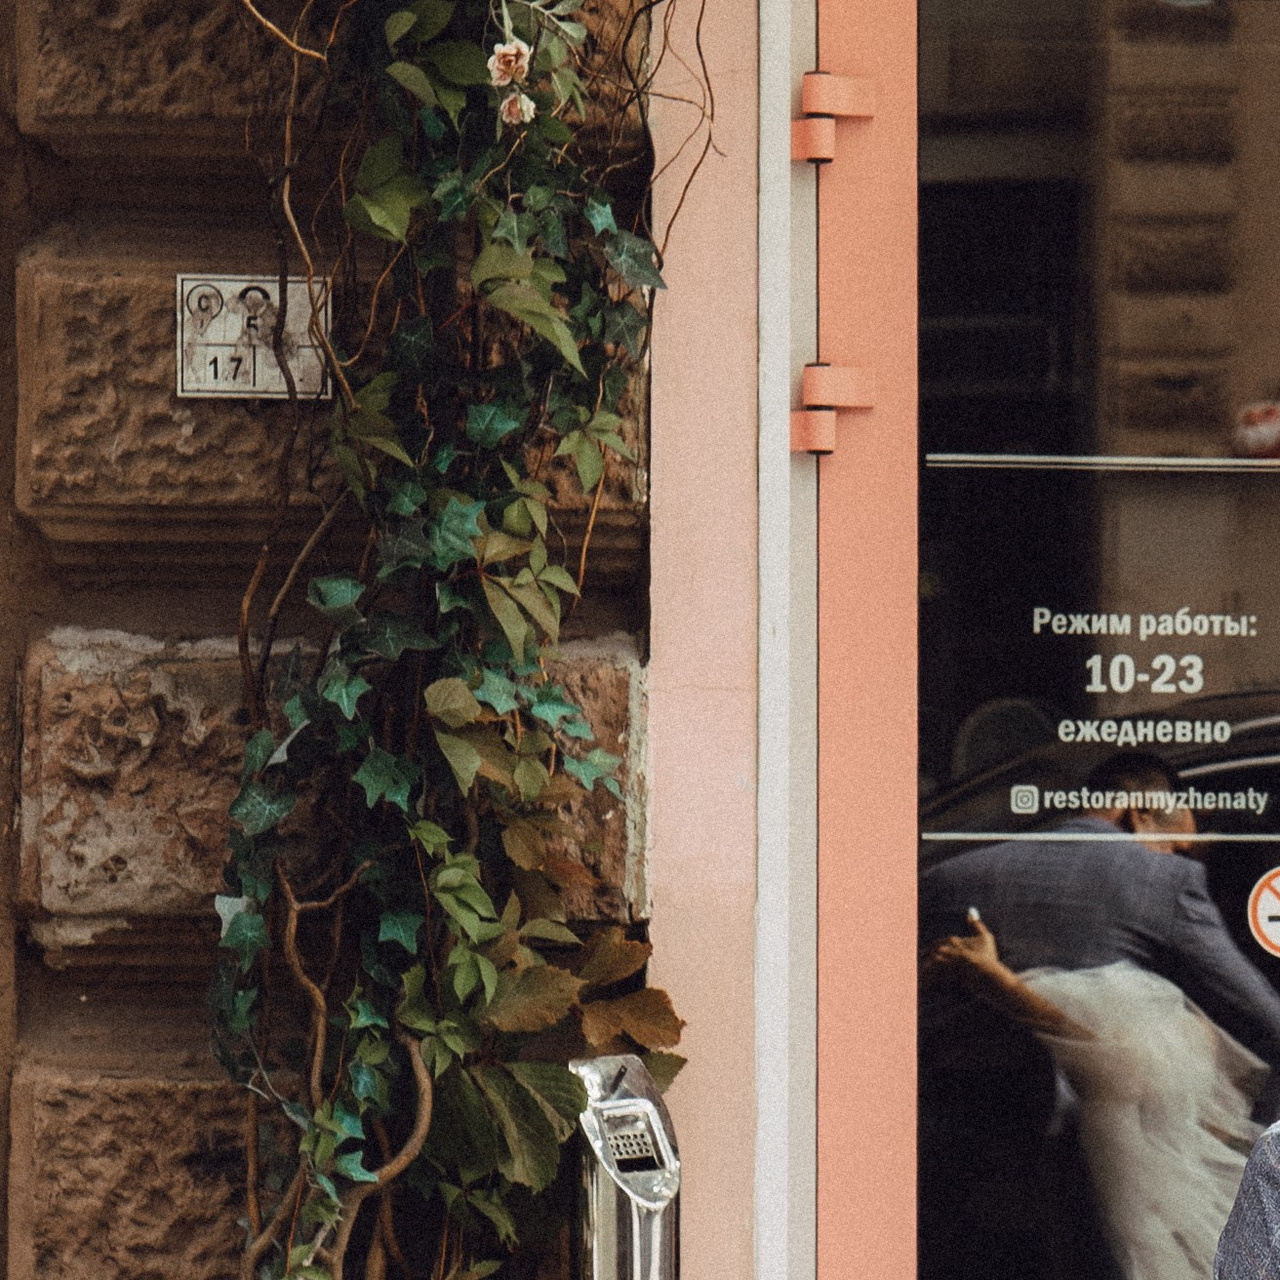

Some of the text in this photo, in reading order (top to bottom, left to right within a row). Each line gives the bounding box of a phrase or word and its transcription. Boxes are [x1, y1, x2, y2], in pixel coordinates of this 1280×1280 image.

[1032, 606, 1258, 642] Режим работы:
[1085, 653, 1205, 694] 10-23
[1057, 719, 1232, 747] ежедневно
[1043, 786, 1269, 816] restoranmyzhenaty
